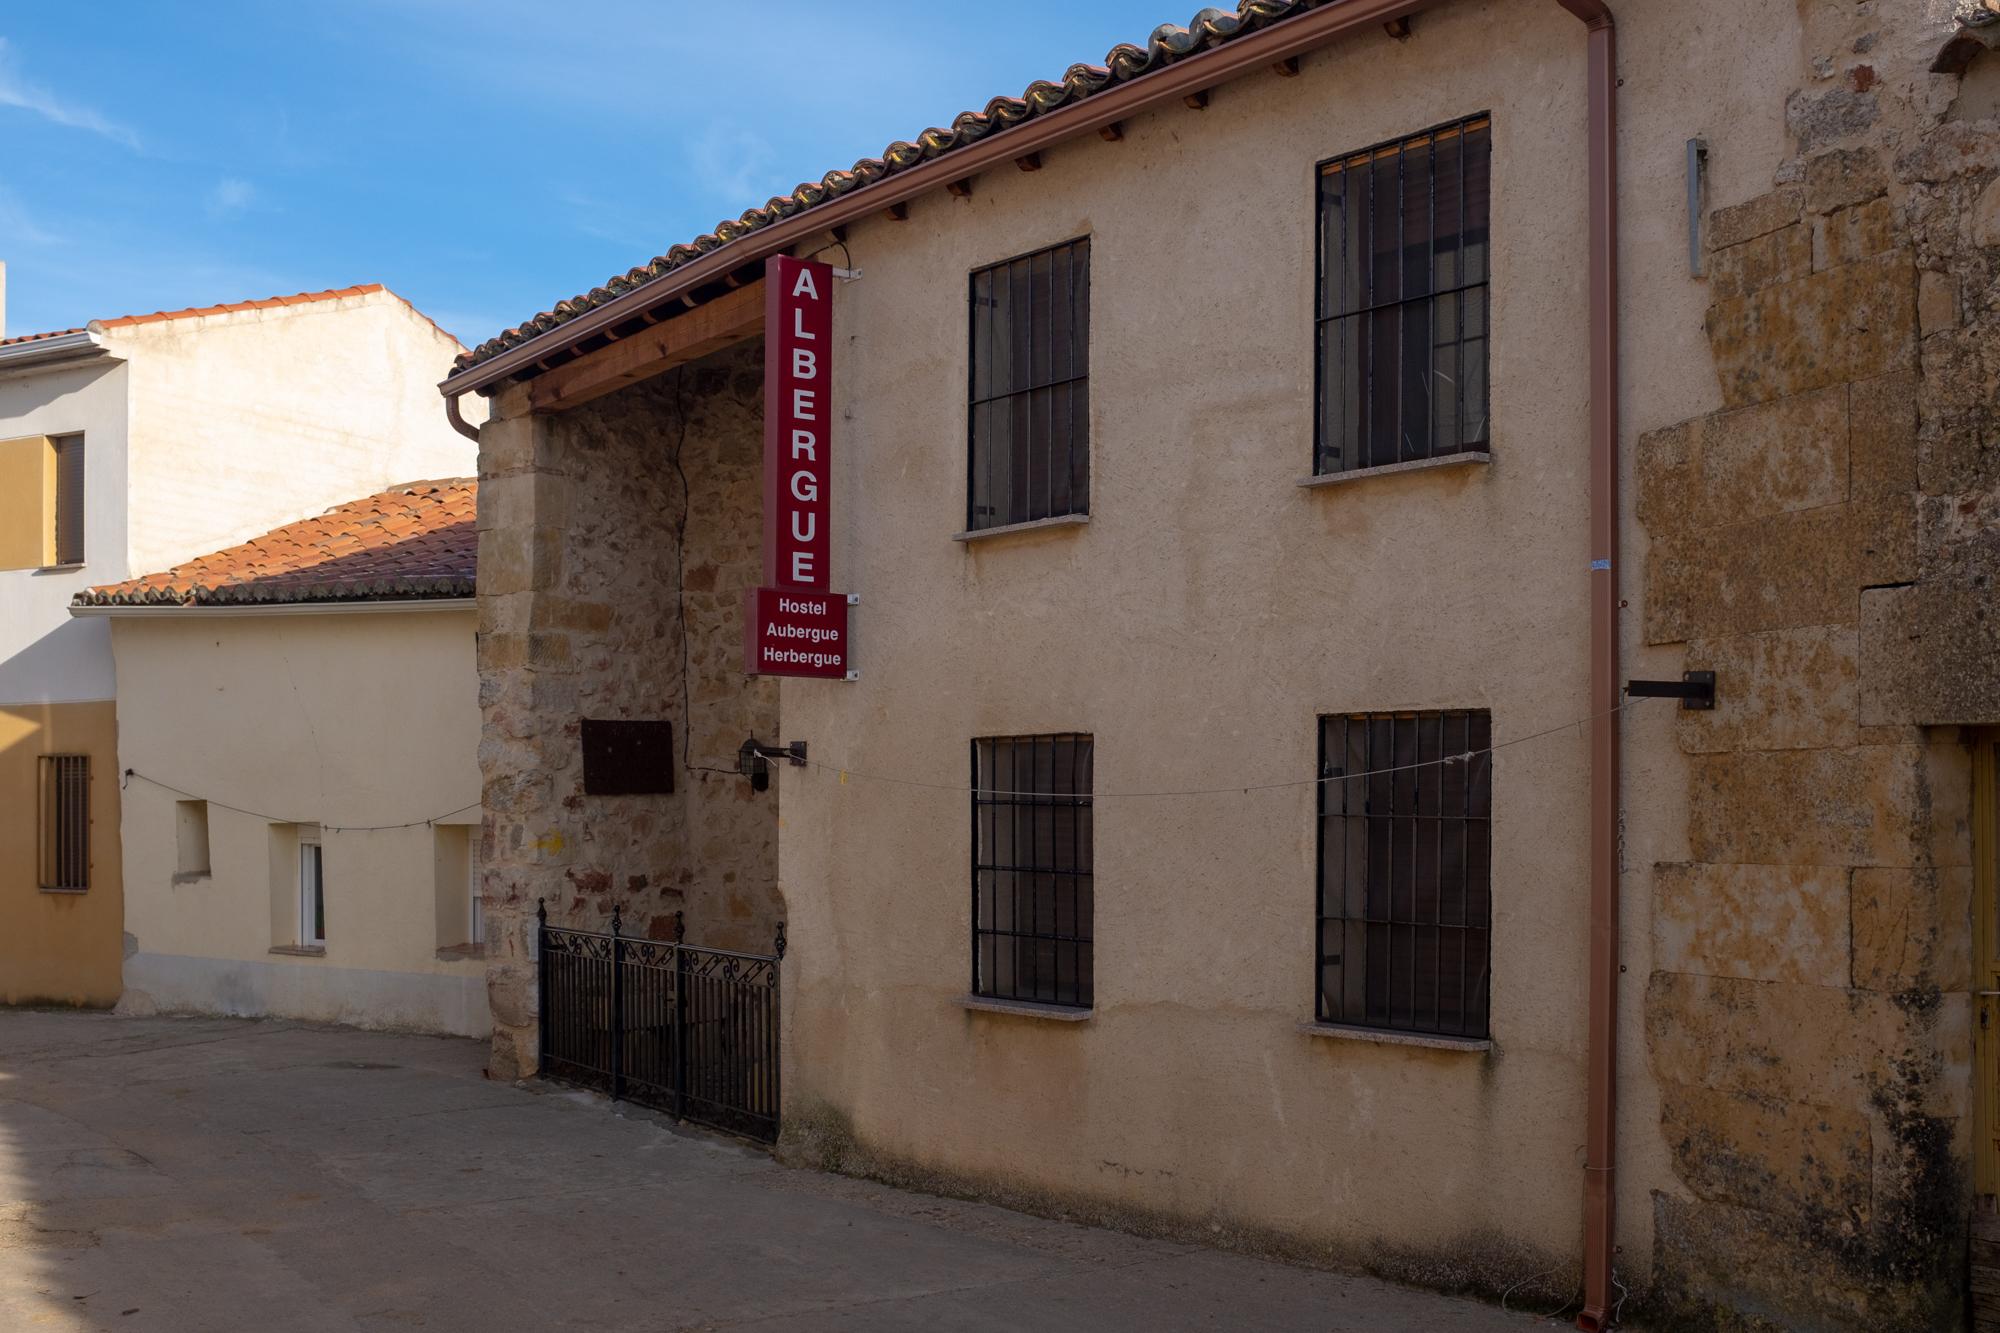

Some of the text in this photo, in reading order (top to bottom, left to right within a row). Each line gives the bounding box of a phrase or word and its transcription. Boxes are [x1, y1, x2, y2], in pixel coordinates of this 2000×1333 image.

[790, 268, 819, 583] ALBERGUE
[779, 598, 827, 616] Hostel
[766, 622, 839, 643] Aubergue
[763, 646, 841, 668] Herbergue
